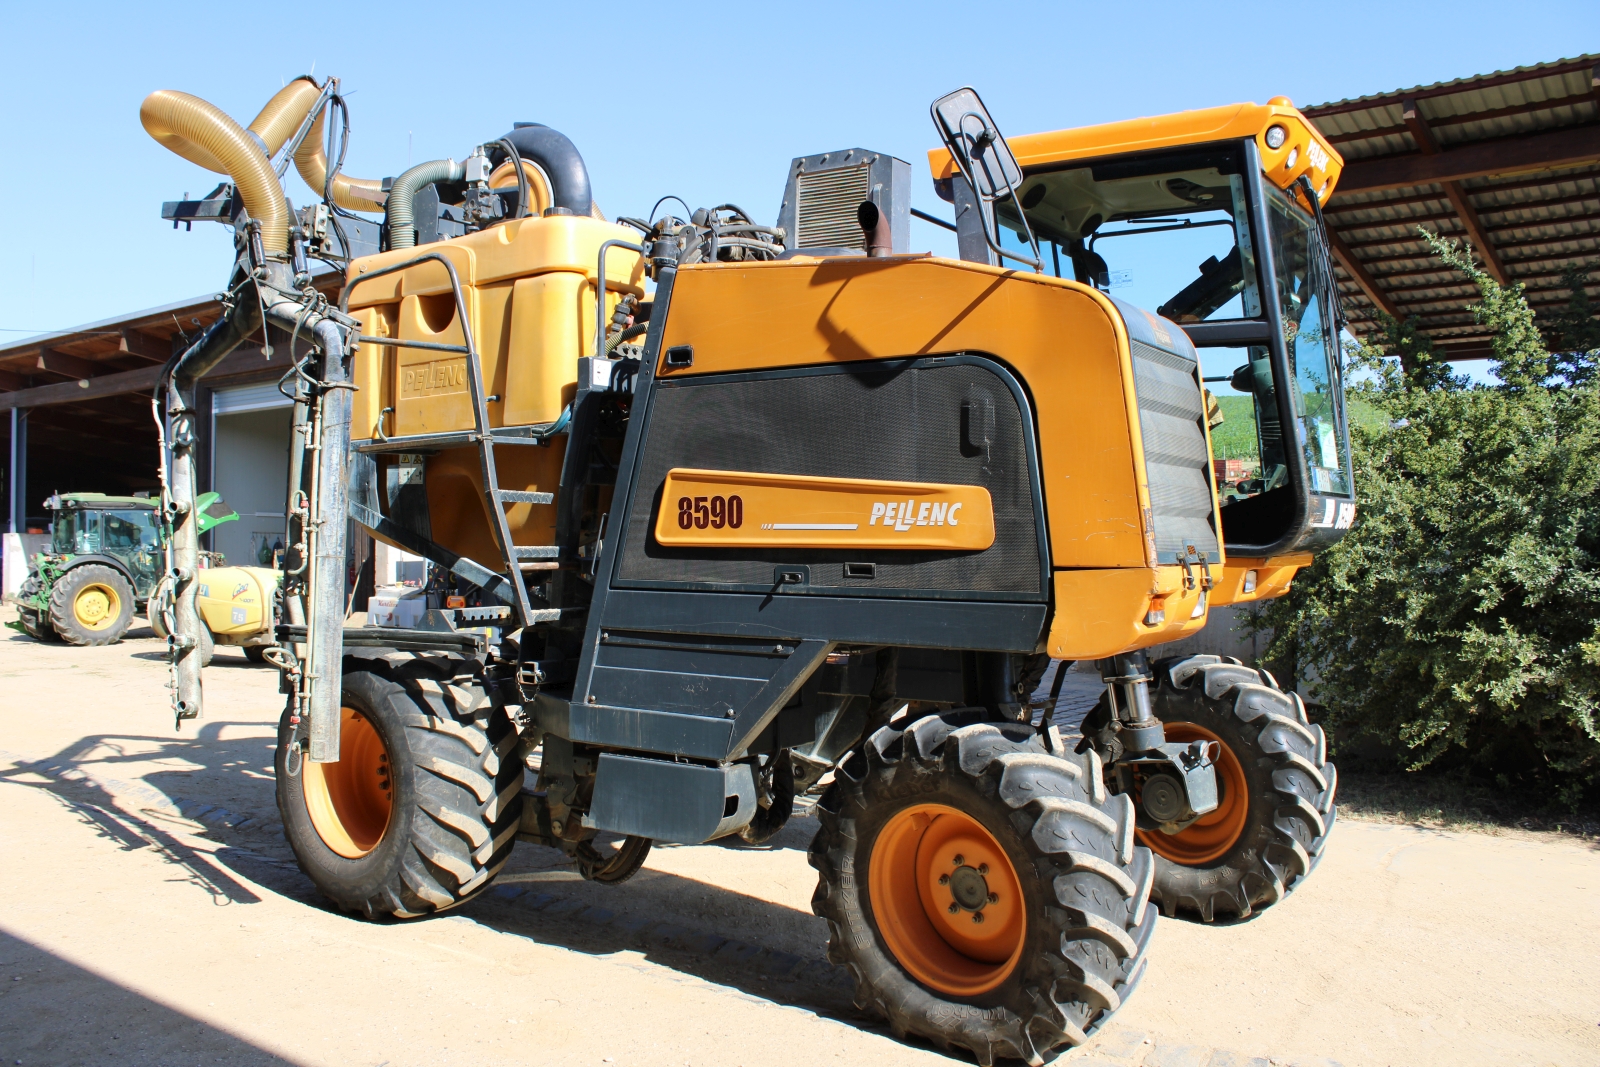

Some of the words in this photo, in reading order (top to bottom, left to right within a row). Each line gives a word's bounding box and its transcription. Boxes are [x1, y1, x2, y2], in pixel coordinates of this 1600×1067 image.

[403, 362, 466, 397] PELLENC
[677, 495, 743, 530] 8590
[868, 499, 963, 532] PELLENC
[232, 611, 244, 622] 75
